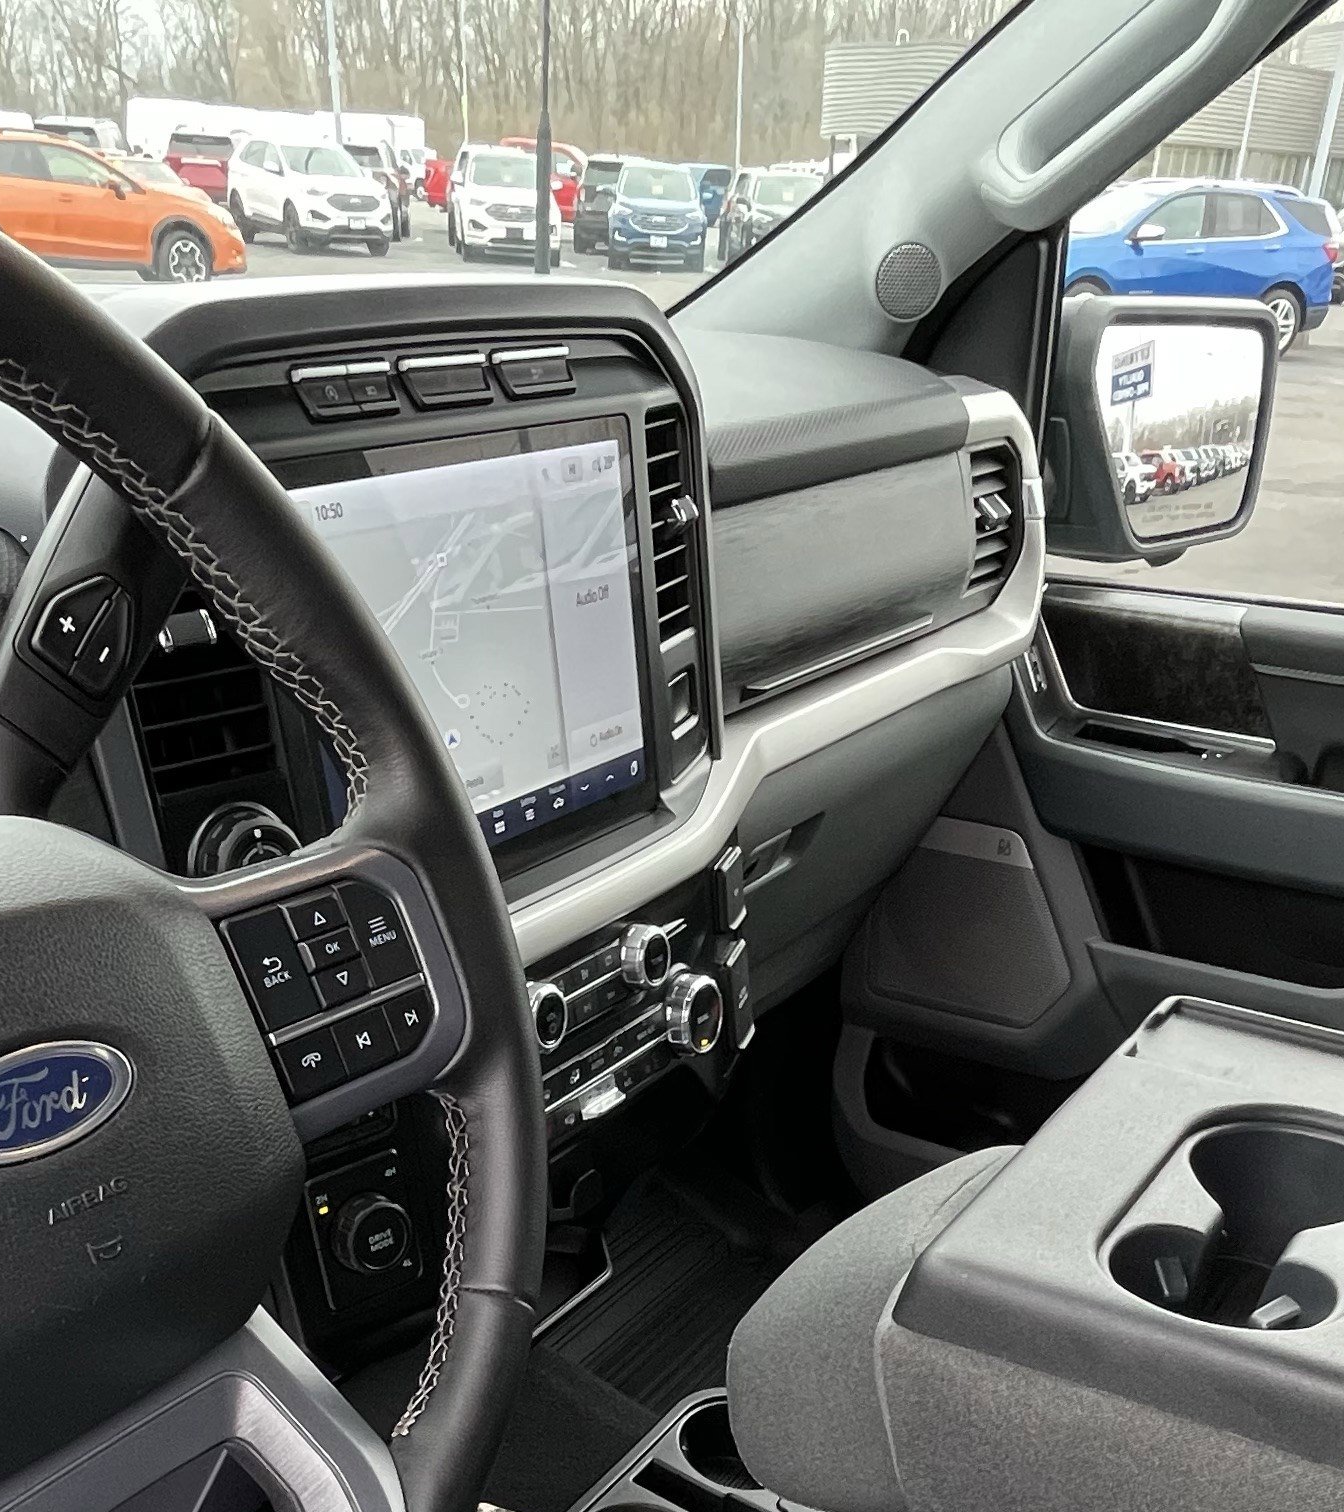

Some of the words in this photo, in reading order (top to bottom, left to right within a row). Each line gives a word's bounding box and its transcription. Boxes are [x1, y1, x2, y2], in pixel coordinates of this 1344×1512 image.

[315, 502, 343, 521] 10:50
[369, 929, 397, 948] MENU
[325, 942, 341, 955] OK
[263, 970, 292, 988] BACK
[48, 1176, 128, 1225] AIRBAG
